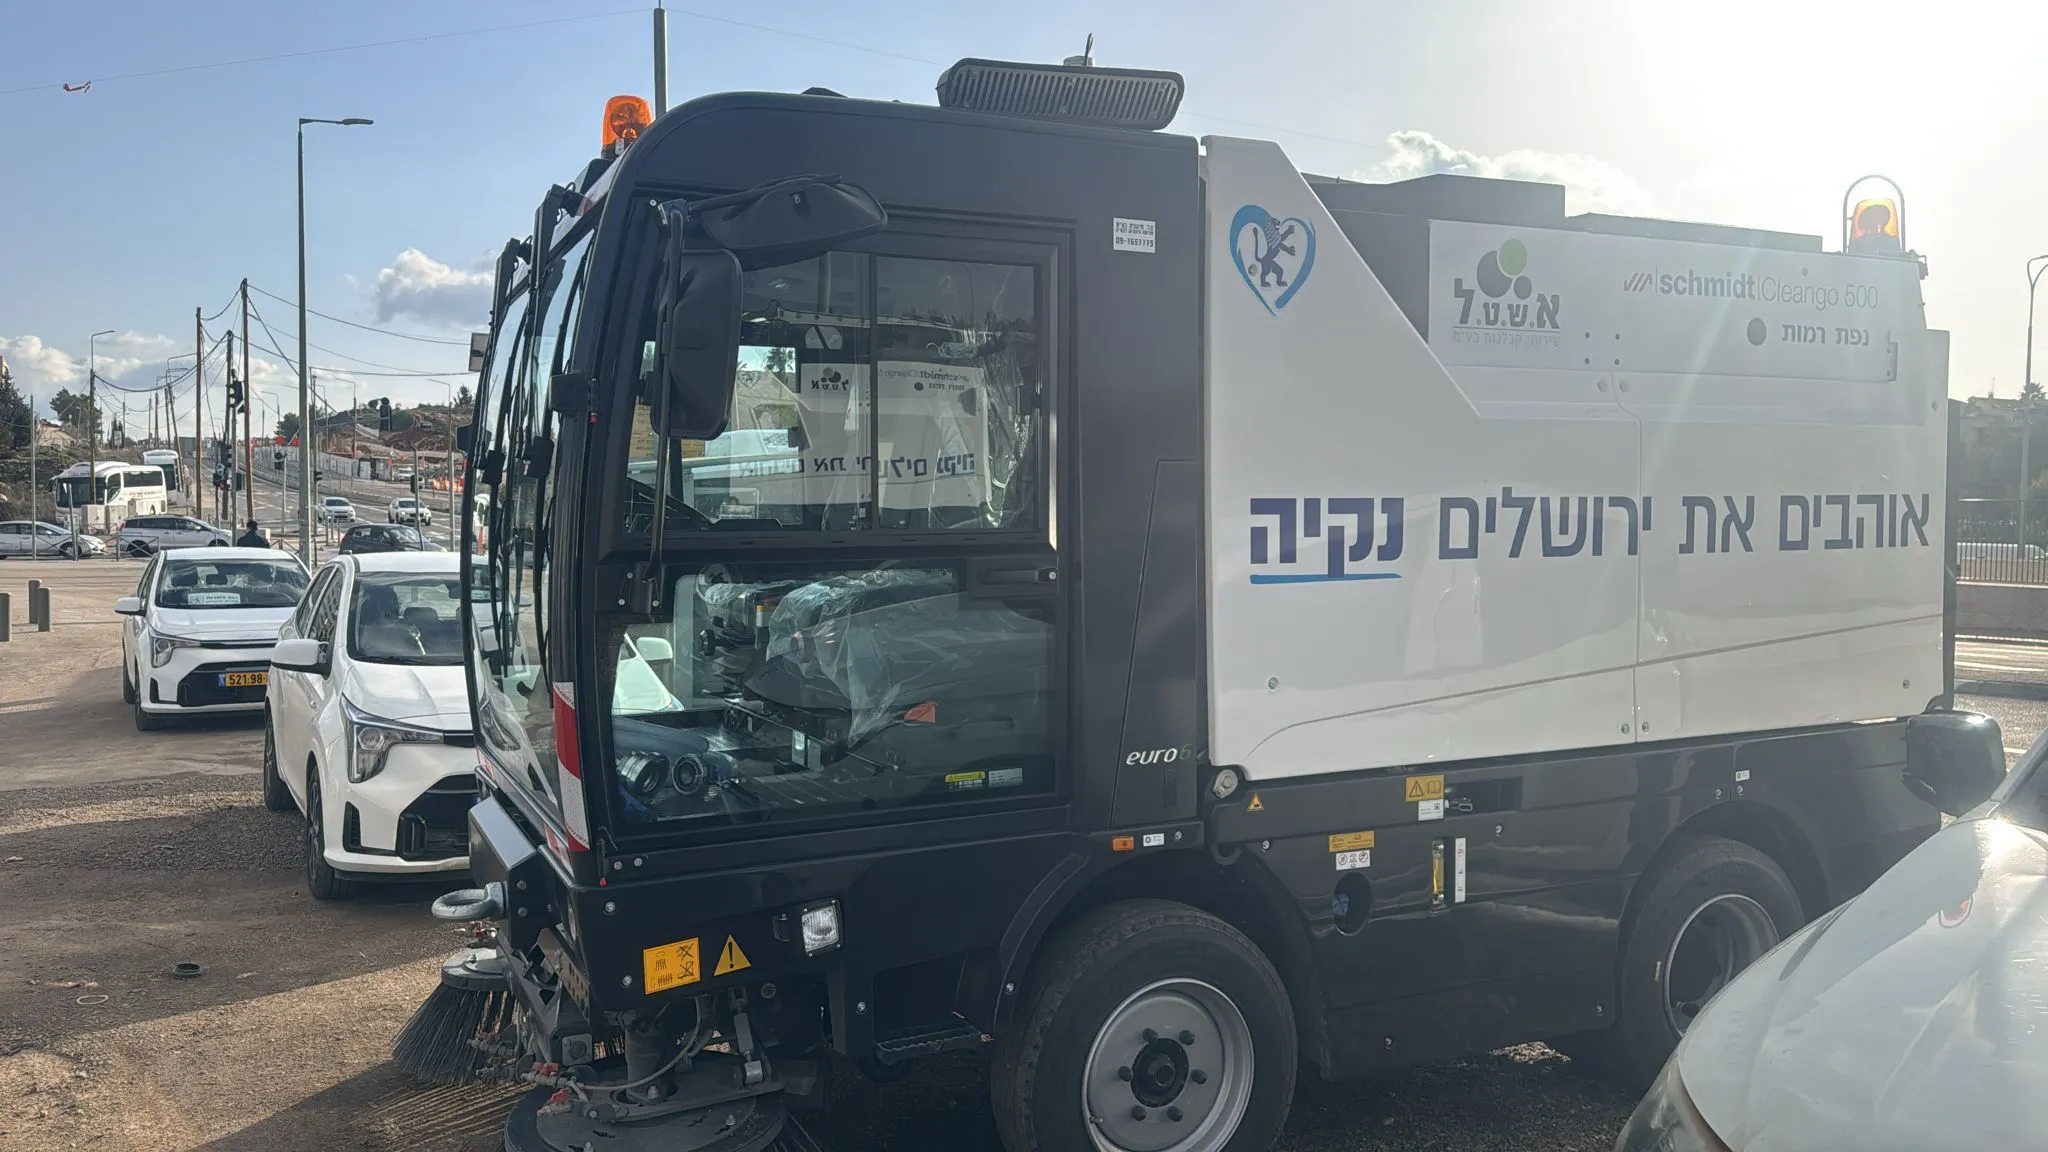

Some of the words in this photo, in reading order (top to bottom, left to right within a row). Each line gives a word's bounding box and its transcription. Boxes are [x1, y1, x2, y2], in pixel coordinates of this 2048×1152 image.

[1659, 269, 1756, 300] schmidt
[1761, 276, 1838, 312] Cleango
[1844, 284, 1879, 309] 500
[1781, 323, 1826, 344] רמות
[1835, 327, 1869, 347] נפת
[1250, 497, 1405, 578] נקיה
[1438, 486, 1652, 560] ירושלים
[1678, 495, 1755, 554] את
[1779, 493, 1930, 551] אוהבים
